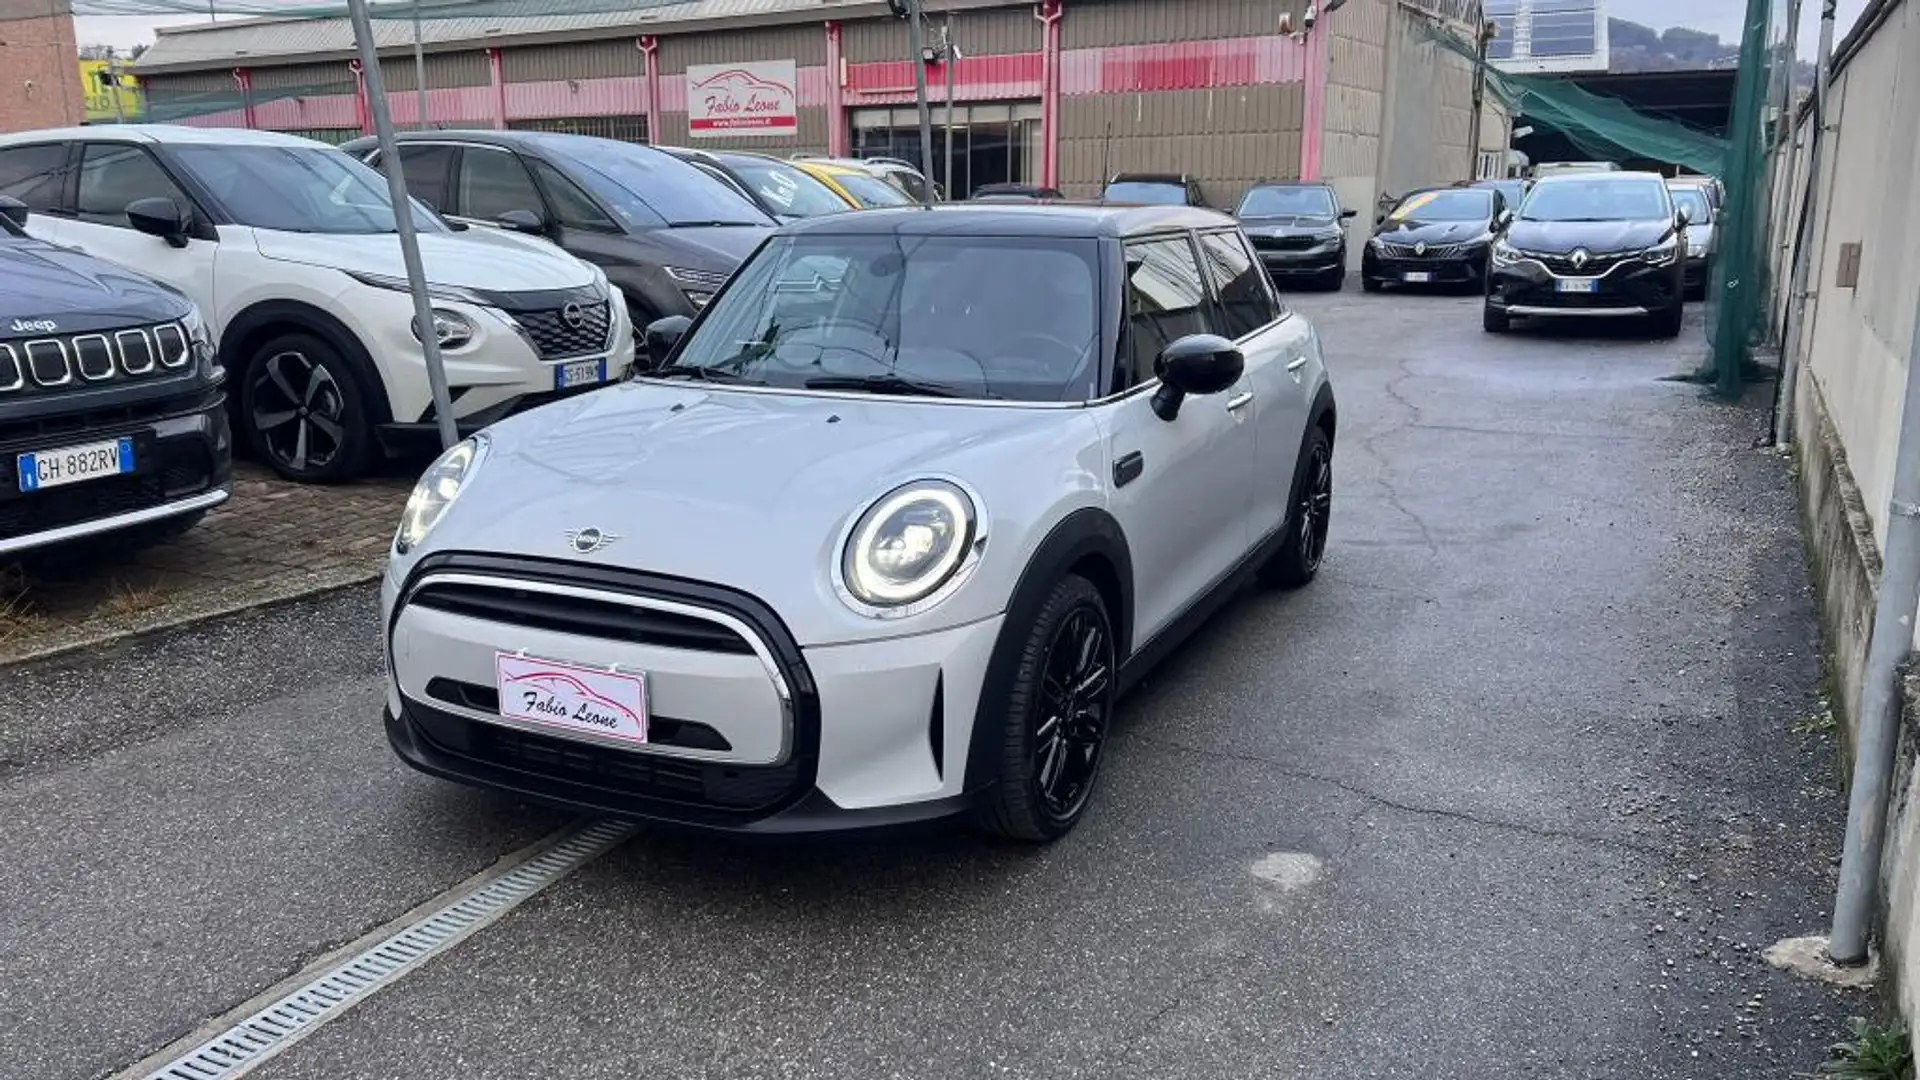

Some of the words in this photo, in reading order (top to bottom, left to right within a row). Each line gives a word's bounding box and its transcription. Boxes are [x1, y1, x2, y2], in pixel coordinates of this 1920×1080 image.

[704, 95, 740, 116] Fabio
[744, 92, 781, 112] Leone
[12, 318, 57, 333] Jeep
[37, 457, 61, 481] GH
[67, 447, 118, 477] 882RV
[523, 691, 568, 717] Fabio
[572, 702, 619, 730] Leone
